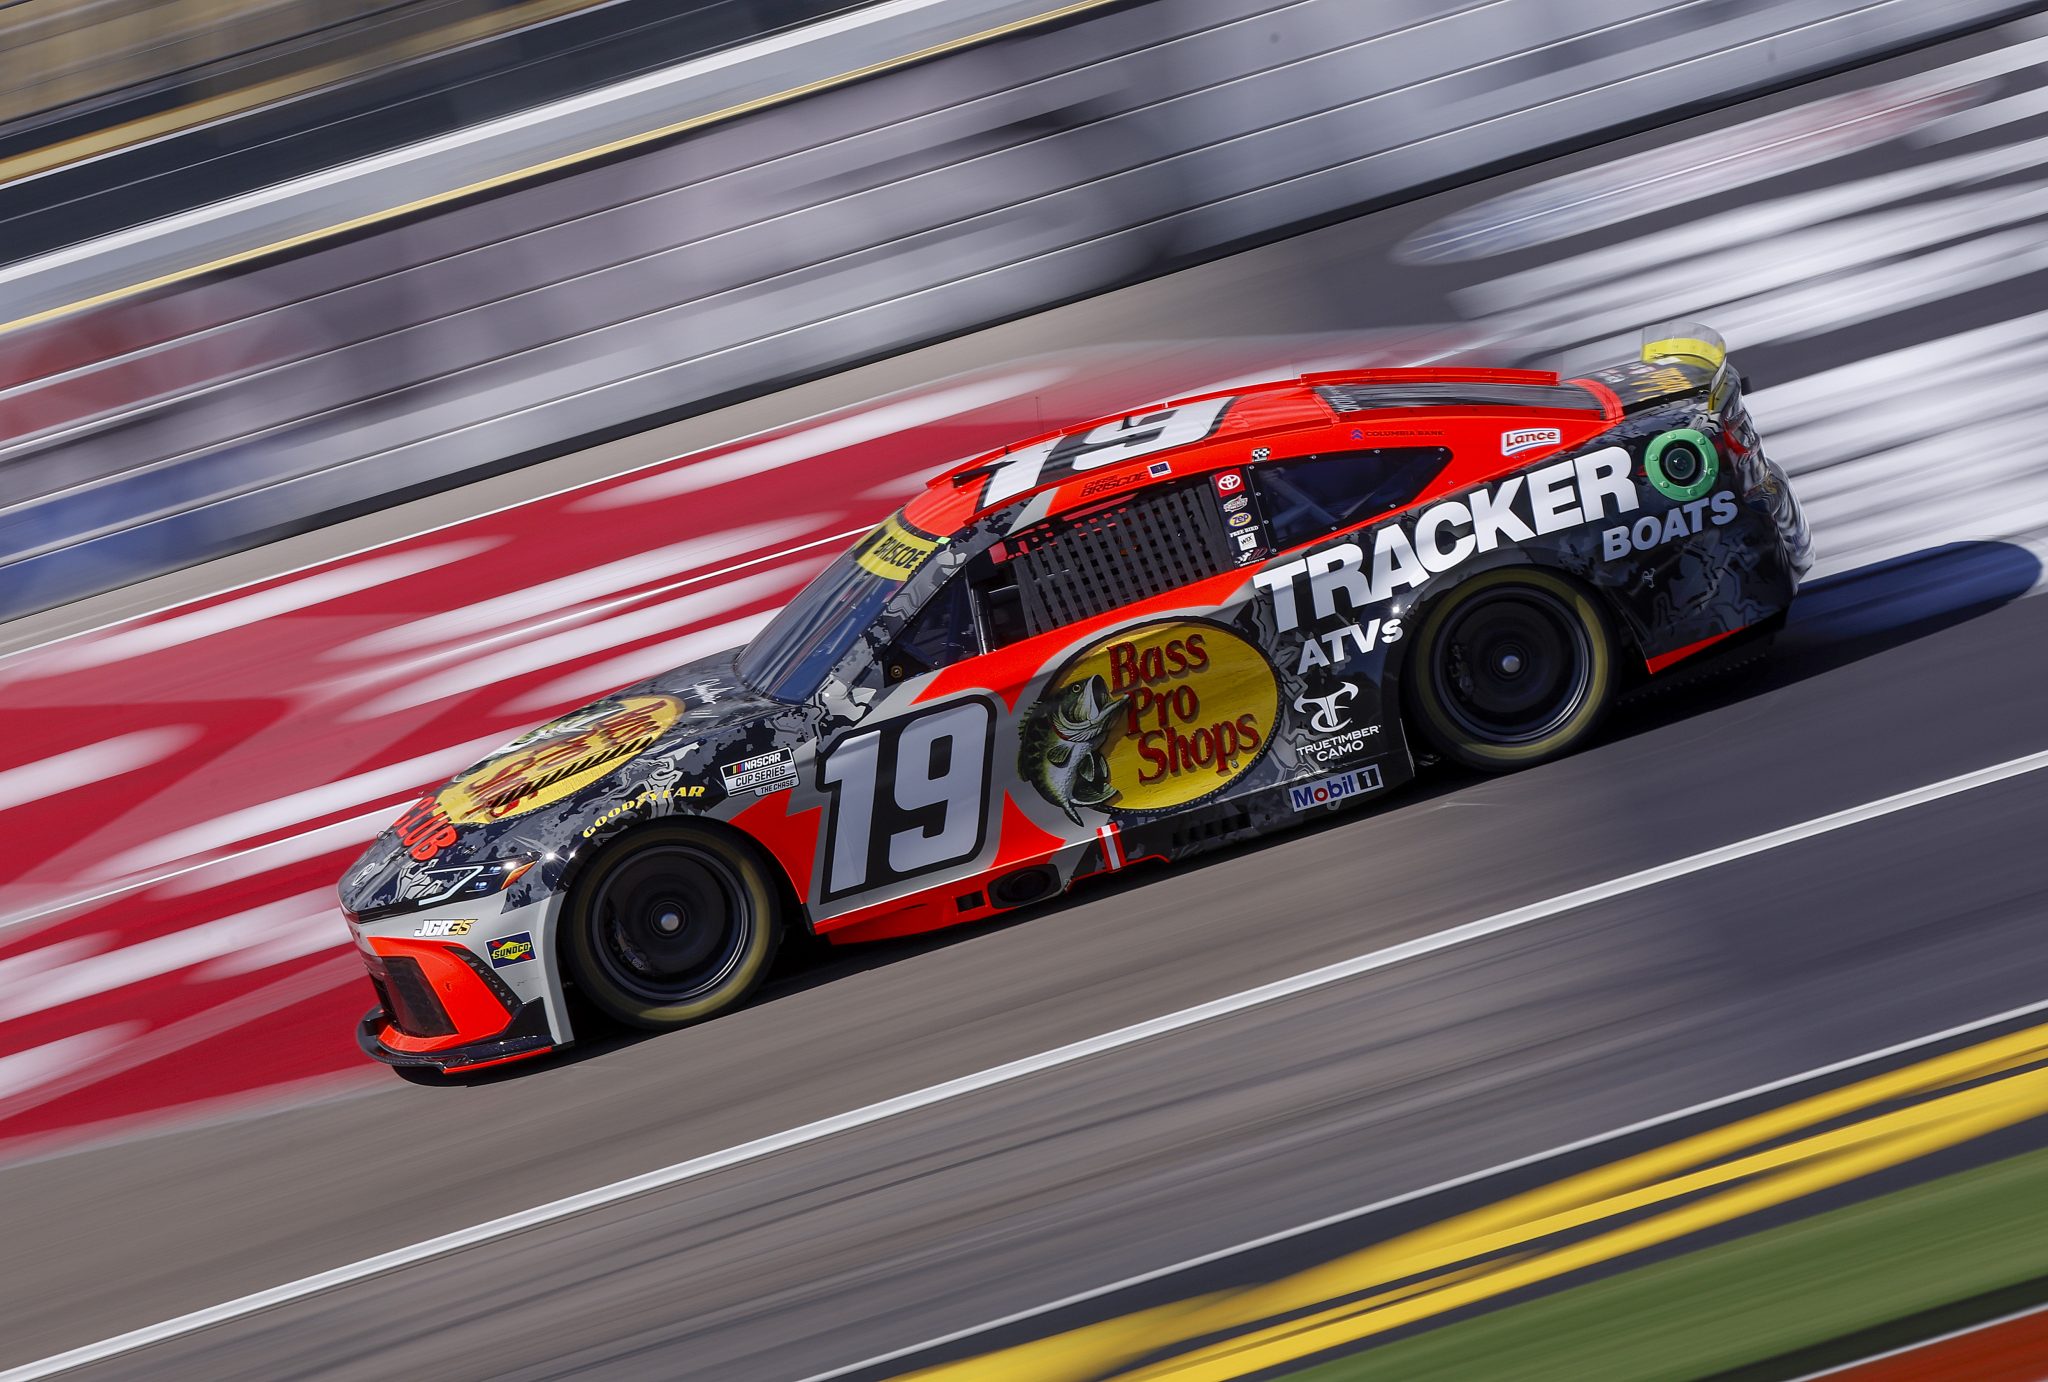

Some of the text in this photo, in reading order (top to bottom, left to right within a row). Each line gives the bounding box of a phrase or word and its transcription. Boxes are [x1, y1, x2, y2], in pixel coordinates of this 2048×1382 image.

[983, 396, 1236, 508] 19
[1506, 431, 1556, 447] Lance
[1080, 471, 1149, 497] BRISCOE
[1253, 446, 1640, 633] TRACKER
[1603, 490, 1739, 562] BOATS
[873, 536, 927, 569] BRISCOE
[1107, 633, 1209, 695] Bass
[1126, 685, 1198, 736] Pro
[1138, 713, 1261, 784] Shops
[1296, 725, 1381, 756] TRUETIMBER
[1316, 740, 1364, 762] CAMO
[735, 765, 786, 788] CUP SERIES
[743, 752, 781, 771] NASCAR
[760, 779, 794, 794] THE CHASE
[824, 702, 989, 894] 19
[1292, 775, 1356, 808] Mobil
[393, 796, 458, 861] CLUB
[582, 786, 706, 839] GOODYEAR
[493, 943, 532, 960] SUNOCO
